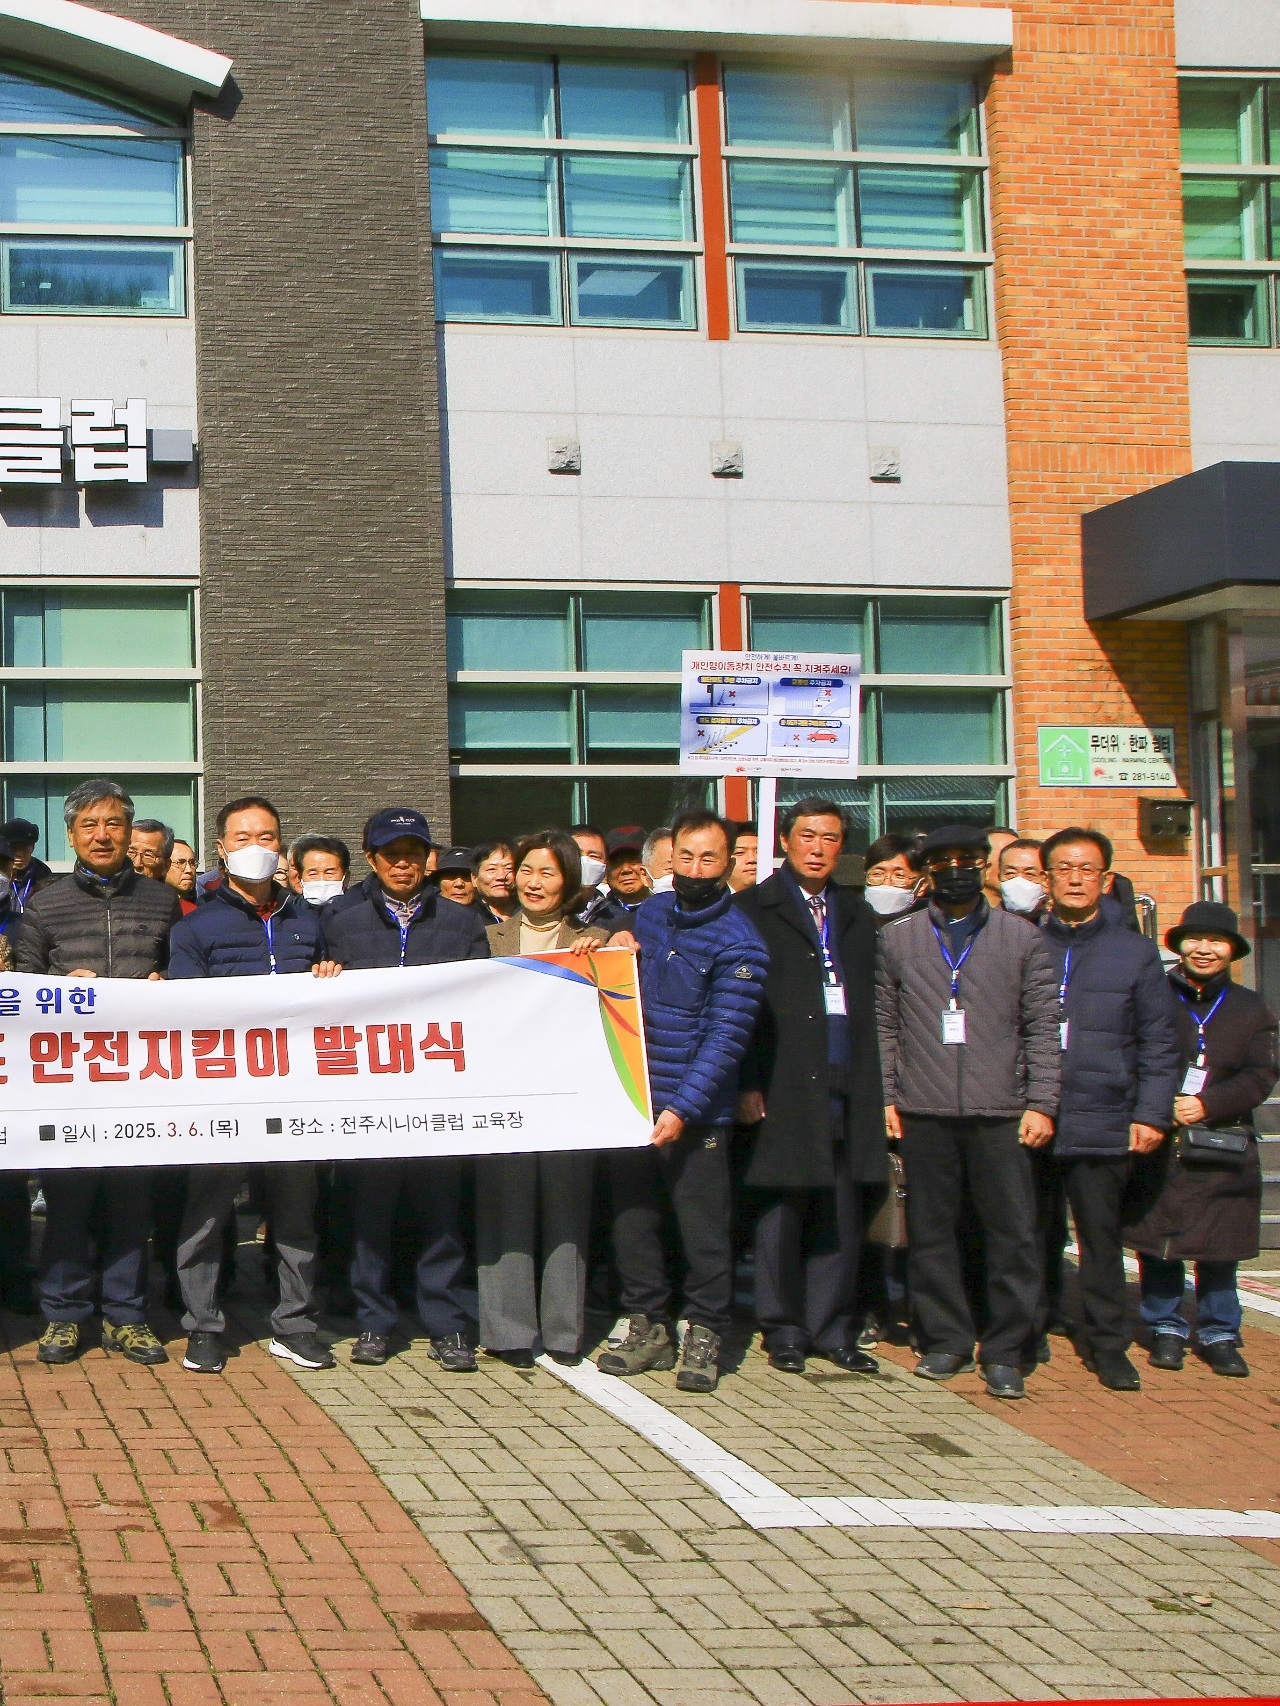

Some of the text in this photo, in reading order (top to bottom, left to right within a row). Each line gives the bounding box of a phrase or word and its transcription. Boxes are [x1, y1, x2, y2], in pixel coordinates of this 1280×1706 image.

[756, 662, 791, 672] 안전수칙
[793, 663, 802, 673] 꼭
[1091, 735, 1120, 753] 무더위
[1129, 735, 1148, 753] 한파
[1132, 772, 1170, 781] 281-5140
[35, 987, 97, 1015] 위한
[29, 1027, 290, 1084] 안전지킴이
[313, 1021, 466, 1076] 발대식
[62, 1125, 96, 1143] 일시
[114, 1123, 161, 1139] 2025.
[167, 1122, 183, 1138] 3.
[188, 1122, 203, 1137] 6.
[210, 1119, 239, 1138] (목)
[288, 1117, 324, 1136] 장소
[340, 1113, 464, 1136] 전주시니어클럽
[471, 1110, 524, 1130] 교육장
